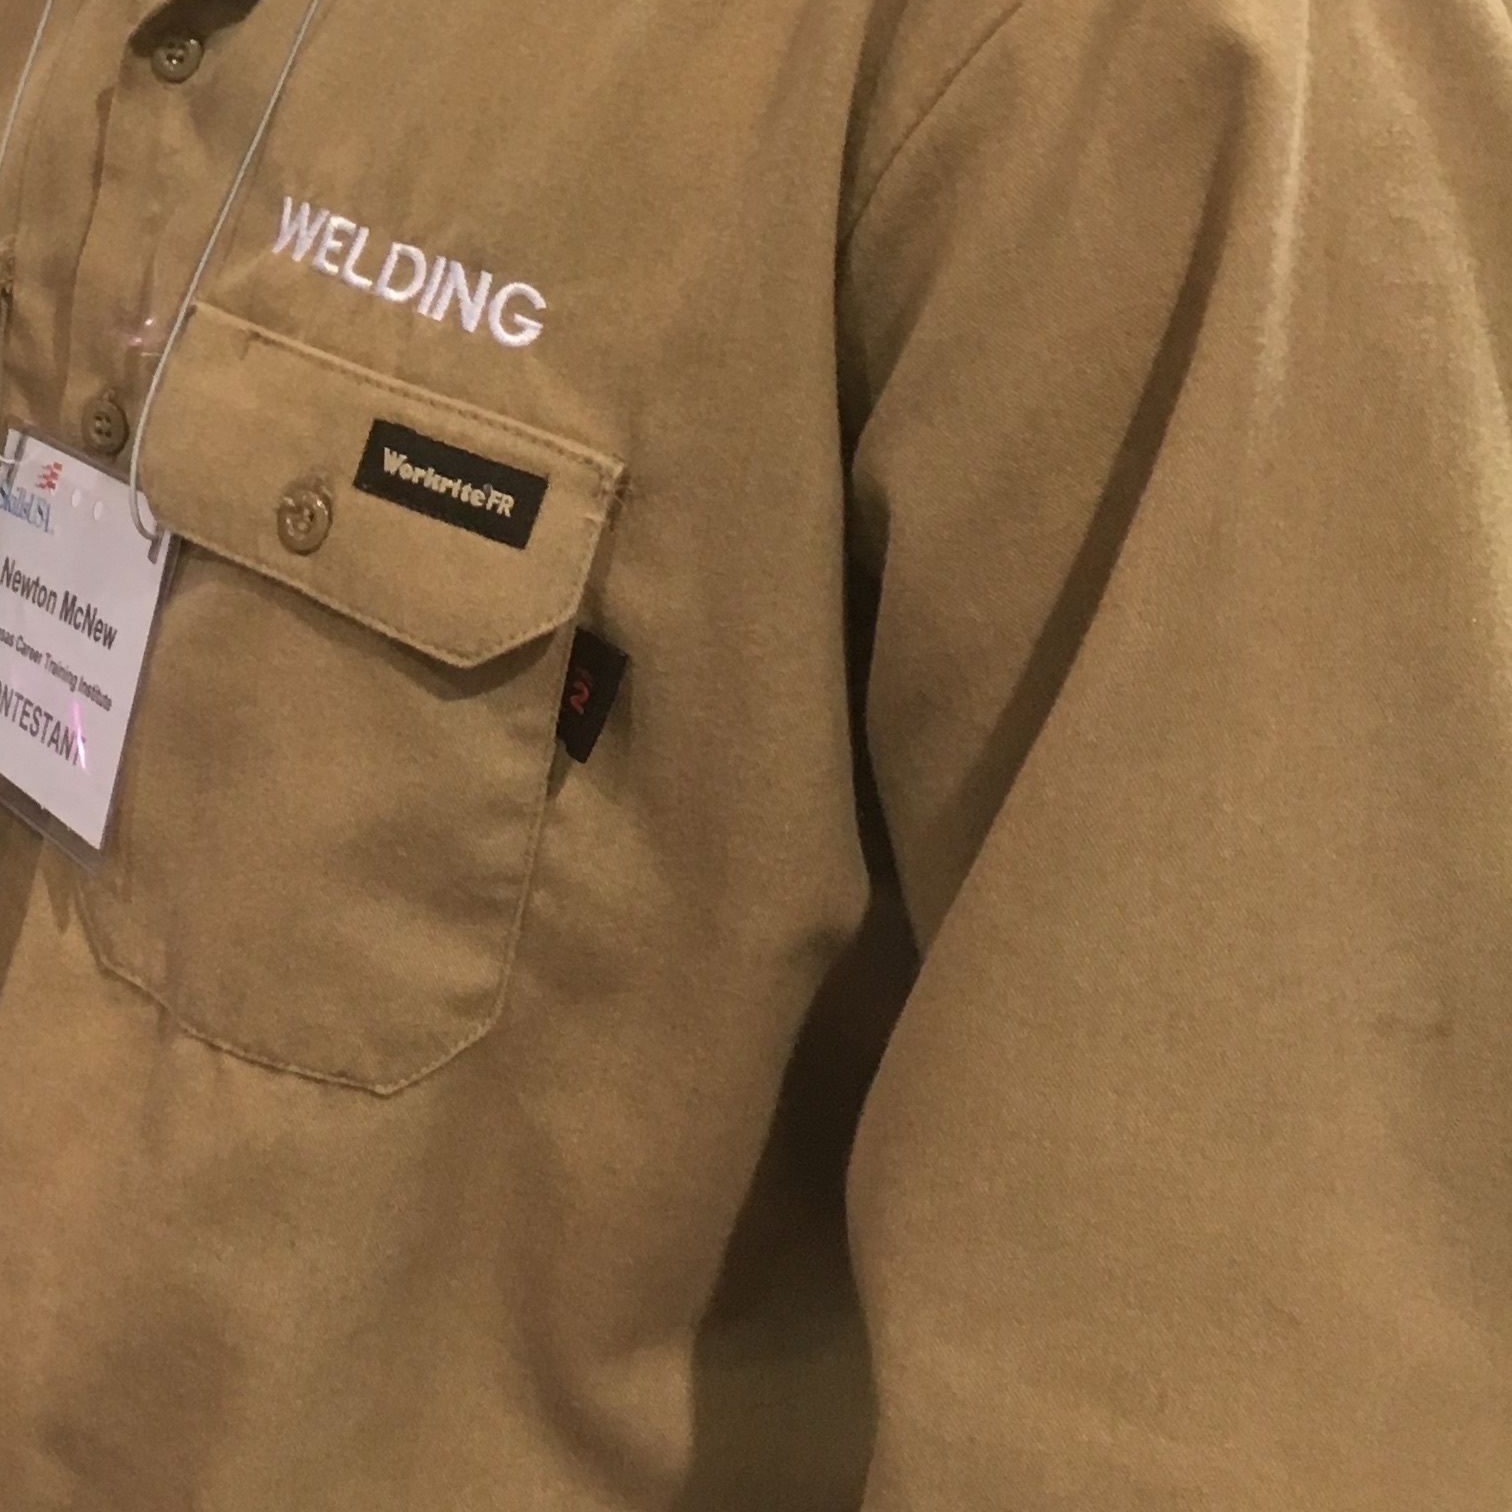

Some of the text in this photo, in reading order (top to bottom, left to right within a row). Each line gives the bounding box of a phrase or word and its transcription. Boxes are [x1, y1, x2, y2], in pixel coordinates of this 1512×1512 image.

[271, 195, 547, 348] WELDING
[0, 555, 119, 650] Newton McNew
